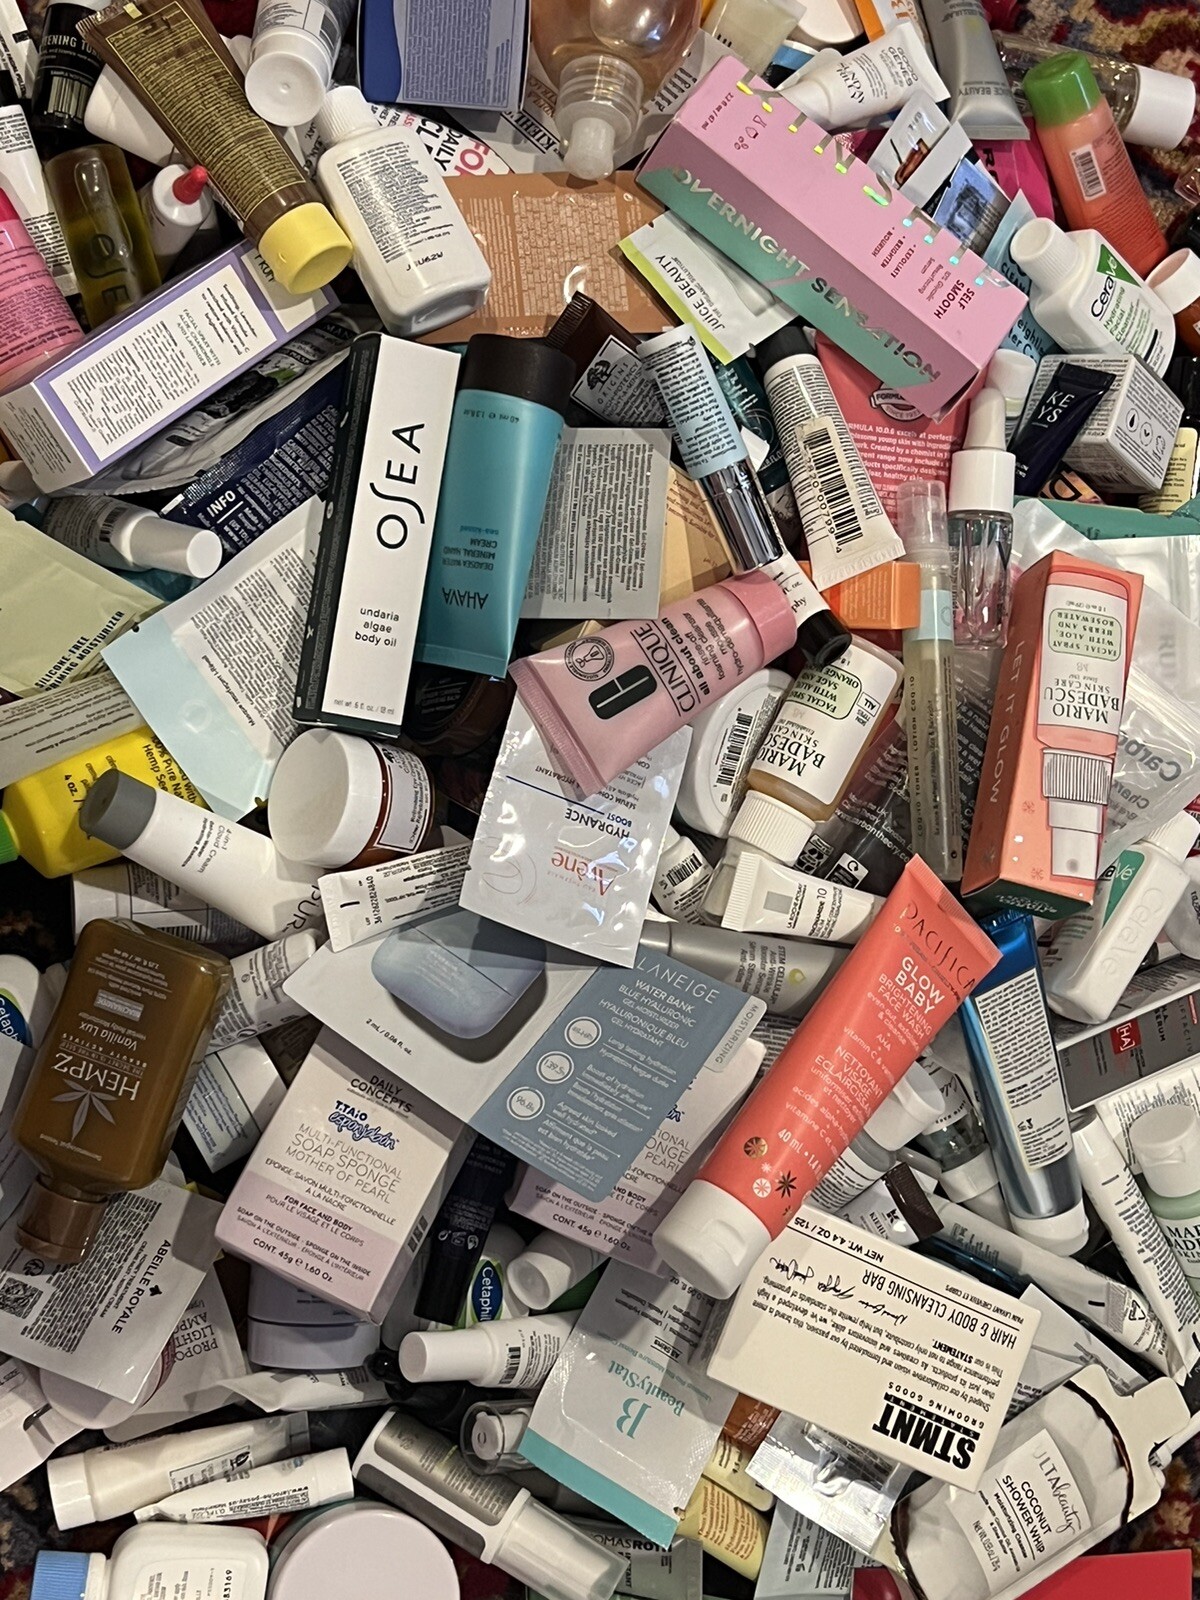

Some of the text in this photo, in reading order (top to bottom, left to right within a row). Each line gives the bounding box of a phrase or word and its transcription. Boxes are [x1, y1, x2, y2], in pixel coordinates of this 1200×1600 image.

[887, 44, 914, 89] GENES
[896, 45, 918, 83] GOOD
[652, 251, 697, 299] BEAUTY
[669, 162, 811, 282] OVERNIGHT
[808, 274, 941, 386] SENSATION
[1091, 251, 1120, 318] CeraVe
[931, 278, 966, 319] SMOOTH
[955, 287, 976, 310] SELF
[1108, 308, 1126, 336] Facial
[870, 443, 896, 452] Created
[205, 489, 237, 517] INFO
[359, 415, 440, 553] OSEA
[468, 537, 497, 548] CREAM
[359, 606, 400, 622] undaria
[438, 586, 489, 610] AHAVA
[72, 608, 129, 663] MOISTURIZER
[353, 630, 397, 647] body oil
[362, 620, 392, 635] algae
[682, 608, 728, 680] foaming cleanser
[703, 619, 728, 656] mousse
[1057, 620, 1077, 629] AND
[1088, 635, 1114, 646] WITH
[33, 633, 91, 690] SILICONE-FREE
[633, 618, 698, 717] CLINIQUE
[660, 614, 711, 696] all about clean
[684, 629, 710, 667] rinse-off
[1083, 644, 1116, 656] FACIAL
[812, 683, 838, 703] WITH
[814, 671, 840, 692] SAGE
[821, 663, 860, 691] ORANGE
[1054, 677, 1110, 693] SKIN CARE
[804, 690, 837, 715] FACIAL
[1043, 685, 1120, 711] BADESCU
[1051, 702, 1109, 724] MARIO
[789, 726, 819, 749] SKIN
[984, 639, 1026, 803] LET IT GLOW
[137, 742, 164, 775] Hemp
[159, 757, 181, 782] Pure
[562, 805, 630, 843] HYDRANCE
[606, 810, 632, 828] BOOST
[197, 824, 227, 875] Cloud Cream
[544, 848, 616, 897] Avène
[815, 886, 827, 900] 10
[634, 977, 695, 1015] WATER BANK
[636, 952, 720, 1007] LANEIGE
[892, 969, 935, 1016] BABY
[898, 953, 946, 1005] GLOW
[597, 997, 689, 1050] HYALURONIQUE BLEU
[617, 983, 697, 1028] BLUE HYALURONIC
[635, 1003, 680, 1030] MOISTURIZER
[876, 971, 936, 1037] BRIGHTENING
[876, 984, 926, 1040] FACE WASH
[77, 1019, 139, 1053] Vanilla Lux
[383, 1031, 398, 1044] 0.06
[622, 1022, 665, 1048] HYDRATANT
[713, 1002, 758, 1065] MOISTURIZING
[874, 1031, 893, 1051] AHA
[49, 1046, 141, 1104] HEMPZ
[368, 1074, 402, 1097] DAILY
[833, 1042, 885, 1099] NETTOYANT
[839, 1061, 874, 1099] VISAGE
[349, 1076, 414, 1114] CONCEPTS
[298, 1122, 404, 1180] MULTI-FUNCTIONAL
[775, 1125, 793, 1144] 40
[284, 1144, 394, 1204] MOTHER OF PEARL
[290, 1131, 335, 1162] SOAP
[335, 1152, 400, 1193] SPONGE
[283, 1193, 353, 1233] FOR FACE AND BODY
[317, 1181, 396, 1227] MULTI-FONCTIONNELLE
[321, 1194, 347, 1211] NACRE
[626, 1190, 646, 1204] BODY
[264, 1193, 365, 1247] POUR VISAGE CORPS
[551, 1212, 619, 1247] CONT. 45g 1.60
[793, 1216, 884, 1263] NET WT. 4.4 OZ 125
[251, 1236, 321, 1276] CONT. 45g 1.60
[305, 1239, 329, 1255] SPONGE
[110, 1237, 172, 1336] ABEILLE ROYALE
[476, 1266, 496, 1321] Cetaphil
[859, 1267, 1018, 1349] HAIR BODY CLEANSING BAR
[172, 1323, 215, 1348] LIGHT
[847, 1341, 992, 1412] Shaped collaborative formulated
[881, 1329, 1000, 1387] performance contribute,
[892, 1347, 995, 1399] than products. creatives
[928, 1338, 1004, 1377] This STATEMENT.
[602, 1357, 690, 1417] BeautyStat
[886, 1380, 985, 1429] GROOMING GOODS
[610, 1393, 652, 1440] B
[886, 1394, 975, 1437] STATEMENT
[870, 1401, 979, 1471] STMNT
[991, 1492, 1032, 1559] Moisturizing Cleanser
[1000, 1474, 1049, 1554] SHOWER WHIP
[1016, 1480, 1056, 1536] COCONUT
